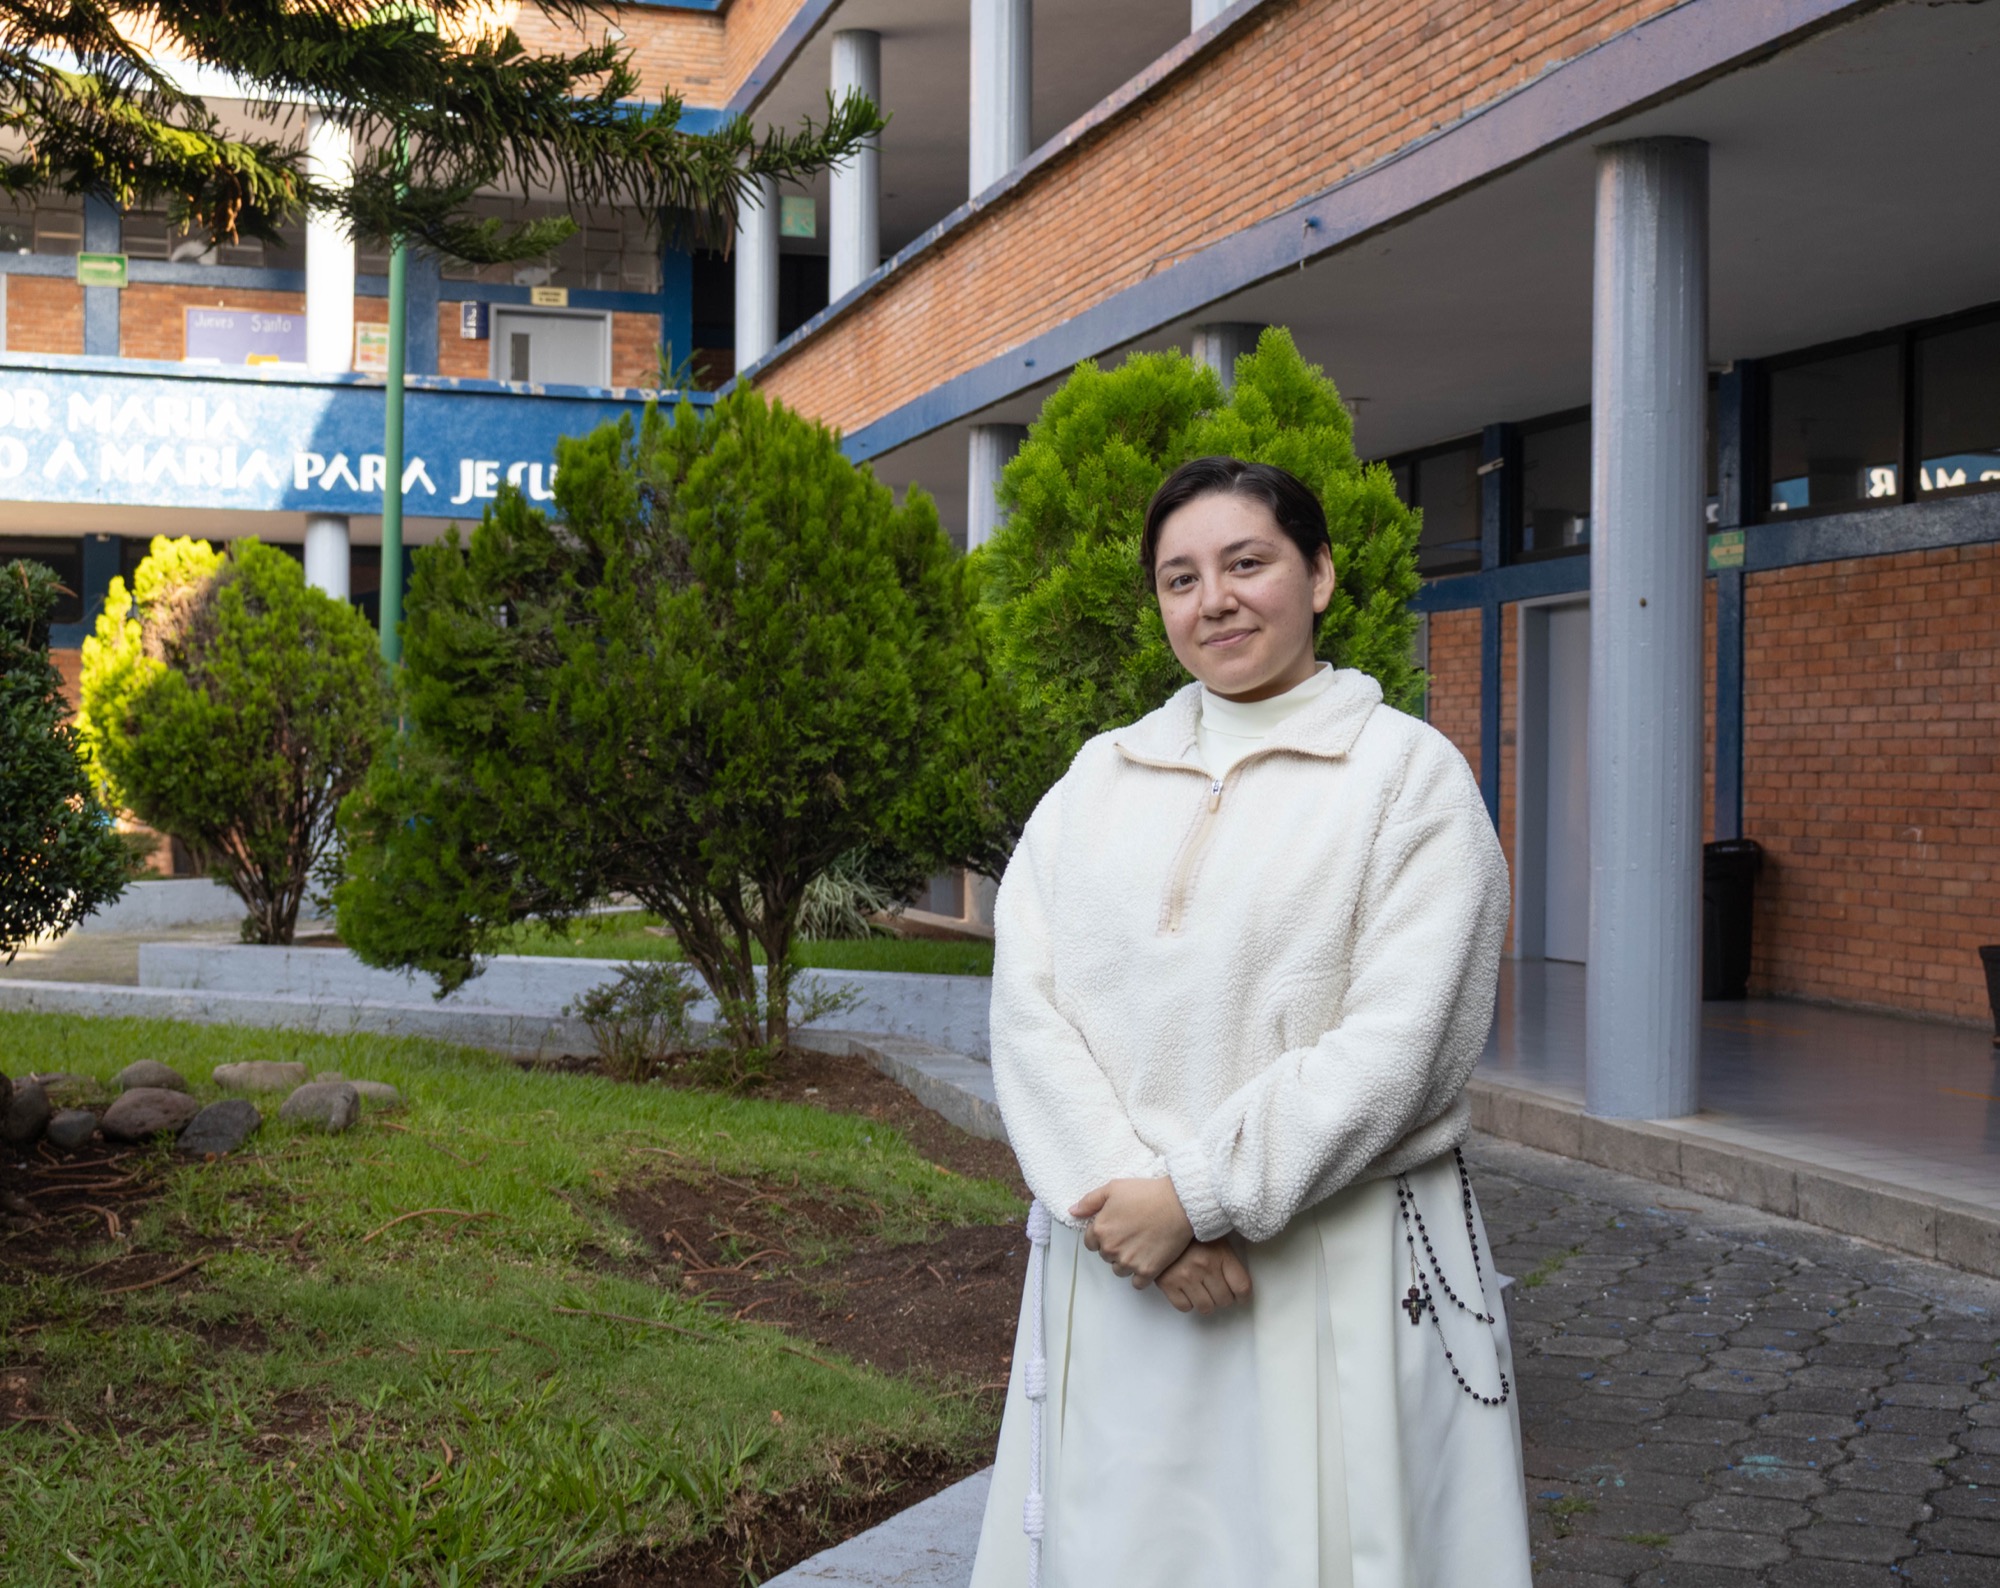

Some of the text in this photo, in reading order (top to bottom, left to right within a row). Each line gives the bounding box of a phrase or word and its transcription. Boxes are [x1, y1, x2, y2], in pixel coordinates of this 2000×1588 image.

[250, 314, 292, 333] Santo
[66, 391, 250, 439] MARIA
[43, 439, 89, 481] A
[100, 442, 281, 490] MARIA
[293, 451, 437, 496] PARA
